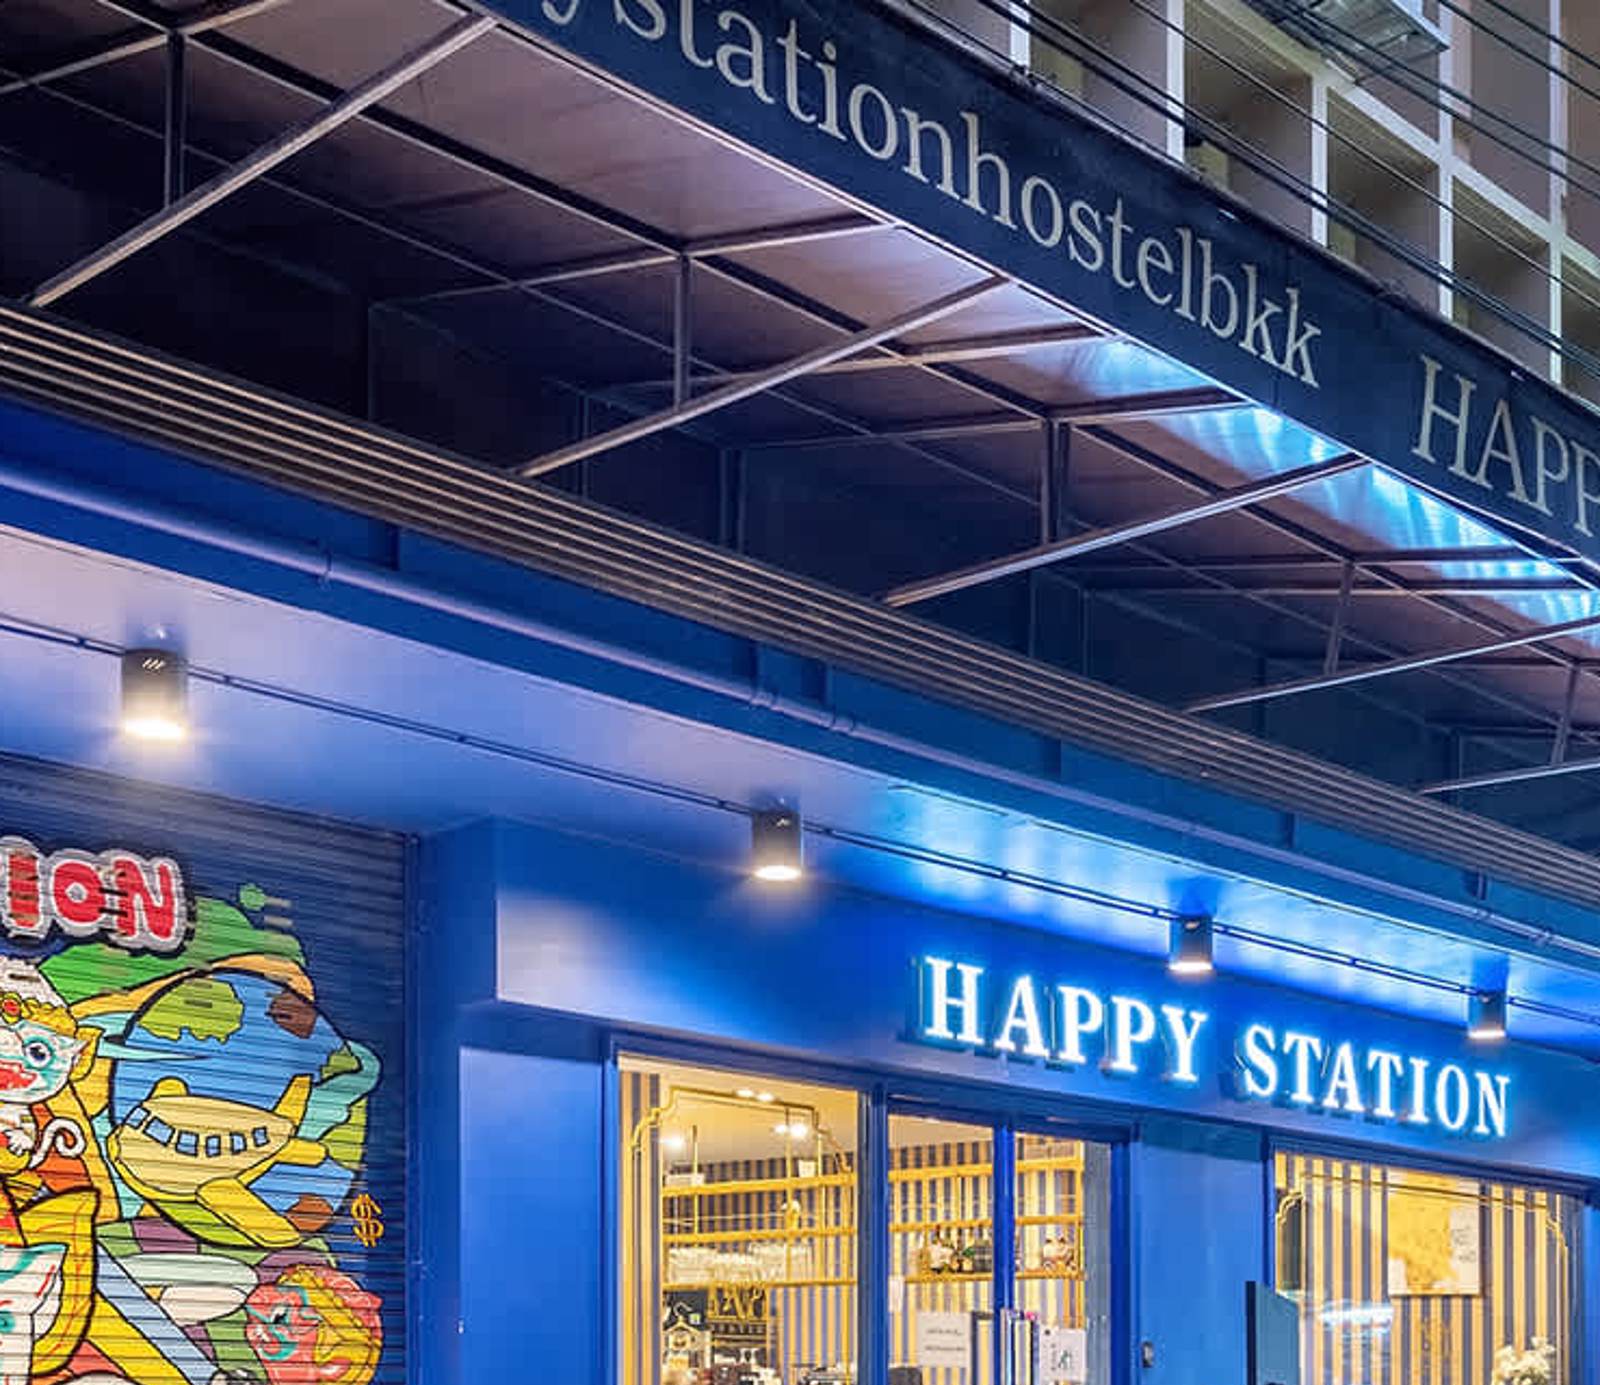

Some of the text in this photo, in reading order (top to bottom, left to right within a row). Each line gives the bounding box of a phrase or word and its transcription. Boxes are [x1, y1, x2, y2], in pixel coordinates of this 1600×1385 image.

[542, 0, 1322, 388] stationhostelbkk
[924, 956, 1512, 1136] HAPPY STATION
